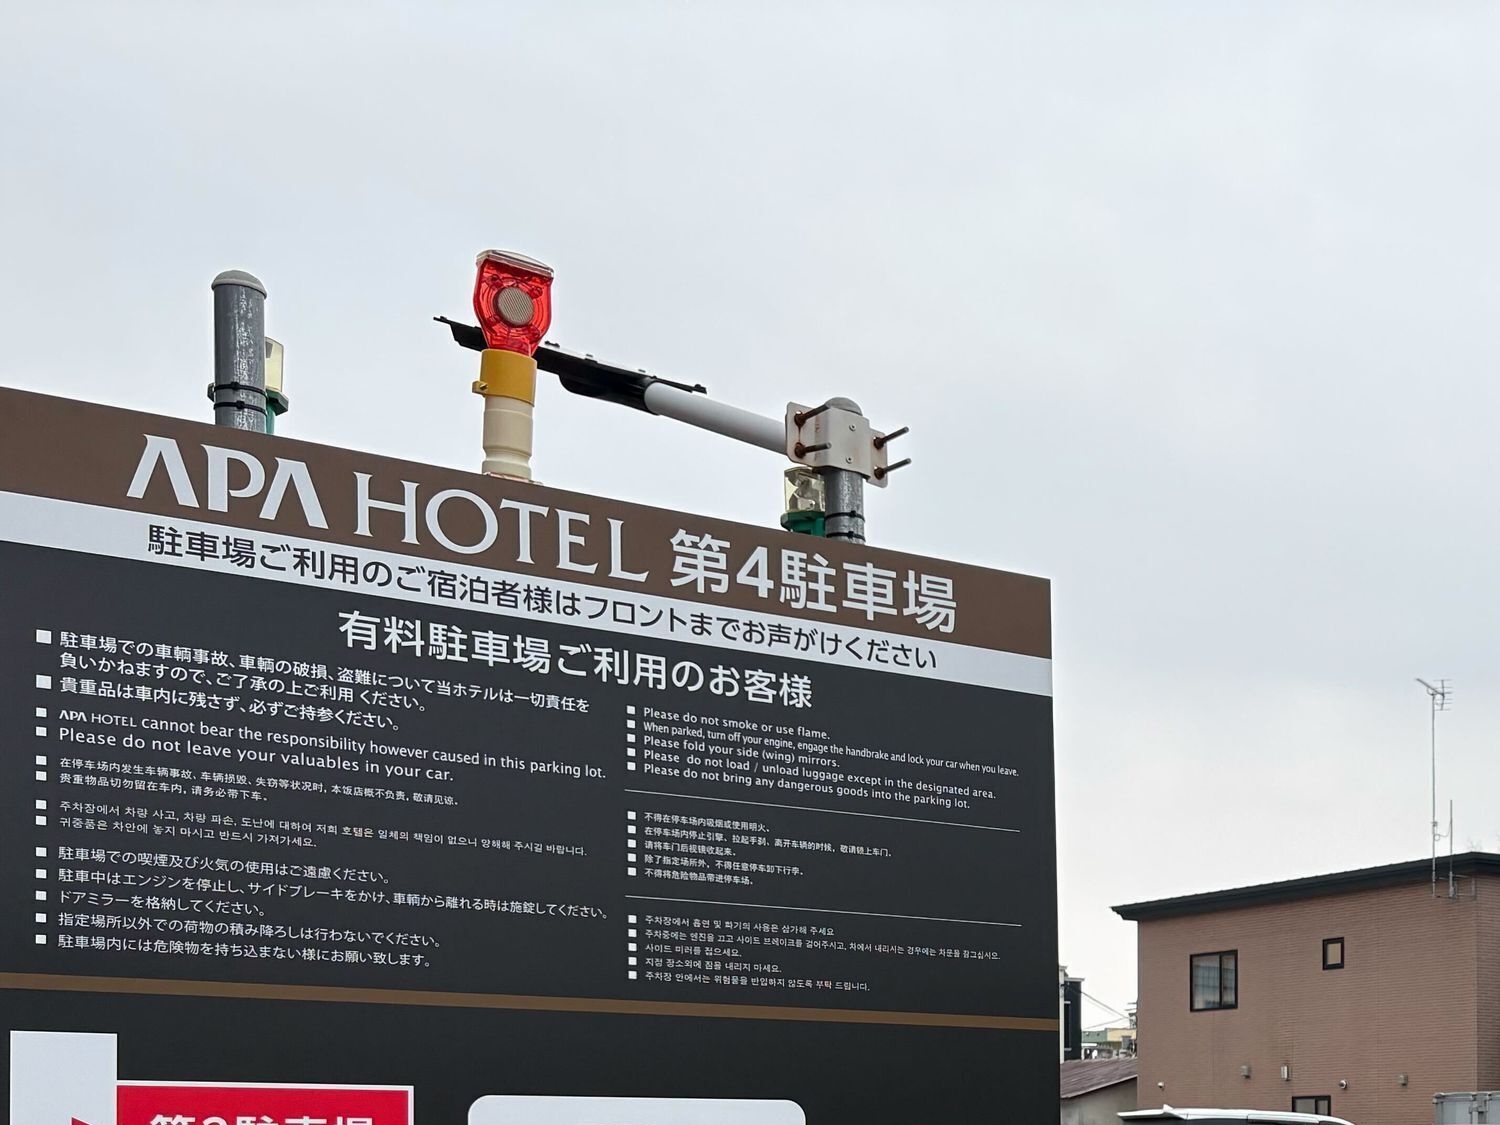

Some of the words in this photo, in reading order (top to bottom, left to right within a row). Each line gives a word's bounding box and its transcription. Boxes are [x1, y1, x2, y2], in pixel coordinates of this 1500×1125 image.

[126, 433, 329, 530] APA
[353, 471, 649, 583] HOTEL
[669, 528, 957, 633] 第4駐車場
[147, 524, 937, 669] 駐車場ご利用のご宿泊者様はフロントまでお声がけください
[59, 651, 354, 703] 負いかねますので、ご了承の上ご利用
[360, 689, 425, 712] ください。
[338, 610, 812, 708] 有料駐車場ご利用のお客様
[59, 676, 399, 731] 貴重品は車内に残さず、必ずご持参ください。
[643, 707, 680, 721] Please
[682, 712, 698, 724] do
[700, 716, 720, 726] not
[722, 719, 758, 731] smoke
[760, 724, 773, 732] or
[775, 726, 795, 736] use
[797, 726, 830, 740] flame.
[58, 709, 88, 722] APA
[91, 713, 137, 728] HOTEL
[141, 718, 195, 734] cannot
[199, 721, 235, 738] bear
[238, 726, 262, 741] the
[267, 732, 366, 755] responsibility
[370, 740, 429, 759] however
[432, 750, 480, 765] caused
[484, 753, 496, 767] in
[500, 755, 526, 770] this
[530, 760, 581, 779] parking
[585, 764, 606, 779] lot.
[59, 727, 116, 746] Please
[122, 733, 146, 749] do
[152, 740, 181, 753] not
[187, 740, 232, 758] leave
[237, 748, 276, 762] your
[280, 752, 359, 771] valuables
[365, 760, 380, 774] in
[384, 764, 422, 778] your
[425, 769, 454, 781] car.
[643, 721, 670, 734] When
[671, 726, 706, 740] parked,
[707, 730, 726, 740] turn
[727, 731, 742, 742] off
[742, 735, 763, 745] your
[763, 737, 796, 750] engine,
[797, 742, 829, 755] engage
[829, 744, 844, 755] the
[845, 745, 889, 761] handbrake
[890, 752, 906, 763] and
[907, 753, 925, 765] lock
[925, 758, 944, 767] your
[945, 760, 958, 769] car
[958, 760, 981, 772] when
[981, 765, 996, 774] you
[997, 764, 1019, 777] leave.
[643, 735, 680, 749] Please
[682, 739, 706, 752] fold
[708, 744, 734, 755] your
[736, 747, 759, 758] side
[761, 749, 795, 764] (wing)
[798, 754, 840, 768] mirrors.
[643, 749, 680, 763] Please
[686, 754, 702, 765] do
[704, 758, 723, 768] not
[726, 758, 750, 771] load
[754, 762, 759, 773] /
[762, 764, 799, 776] unload
[802, 767, 845, 783] luggage
[847, 774, 882, 787] except
[884, 777, 894, 787] in
[896, 778, 913, 790] the
[915, 780, 970, 796] designated
[972, 789, 996, 799] area.
[644, 763, 680, 777] Please
[682, 767, 698, 779] do
[701, 771, 720, 782] not
[723, 771, 752, 787] bring
[755, 777, 775, 789] any
[777, 778, 834, 794] dangerous
[836, 786, 869, 798] goods
[871, 789, 892, 800] into
[894, 791, 911, 802] the
[913, 795, 952, 809] parking
[954, 797, 970, 809] lot.
[58, 846, 389, 884] 駐車場での喫煙及び火気の使用はご遠慮ください。
[61, 890, 265, 917] ドアミラーを格納してください。
